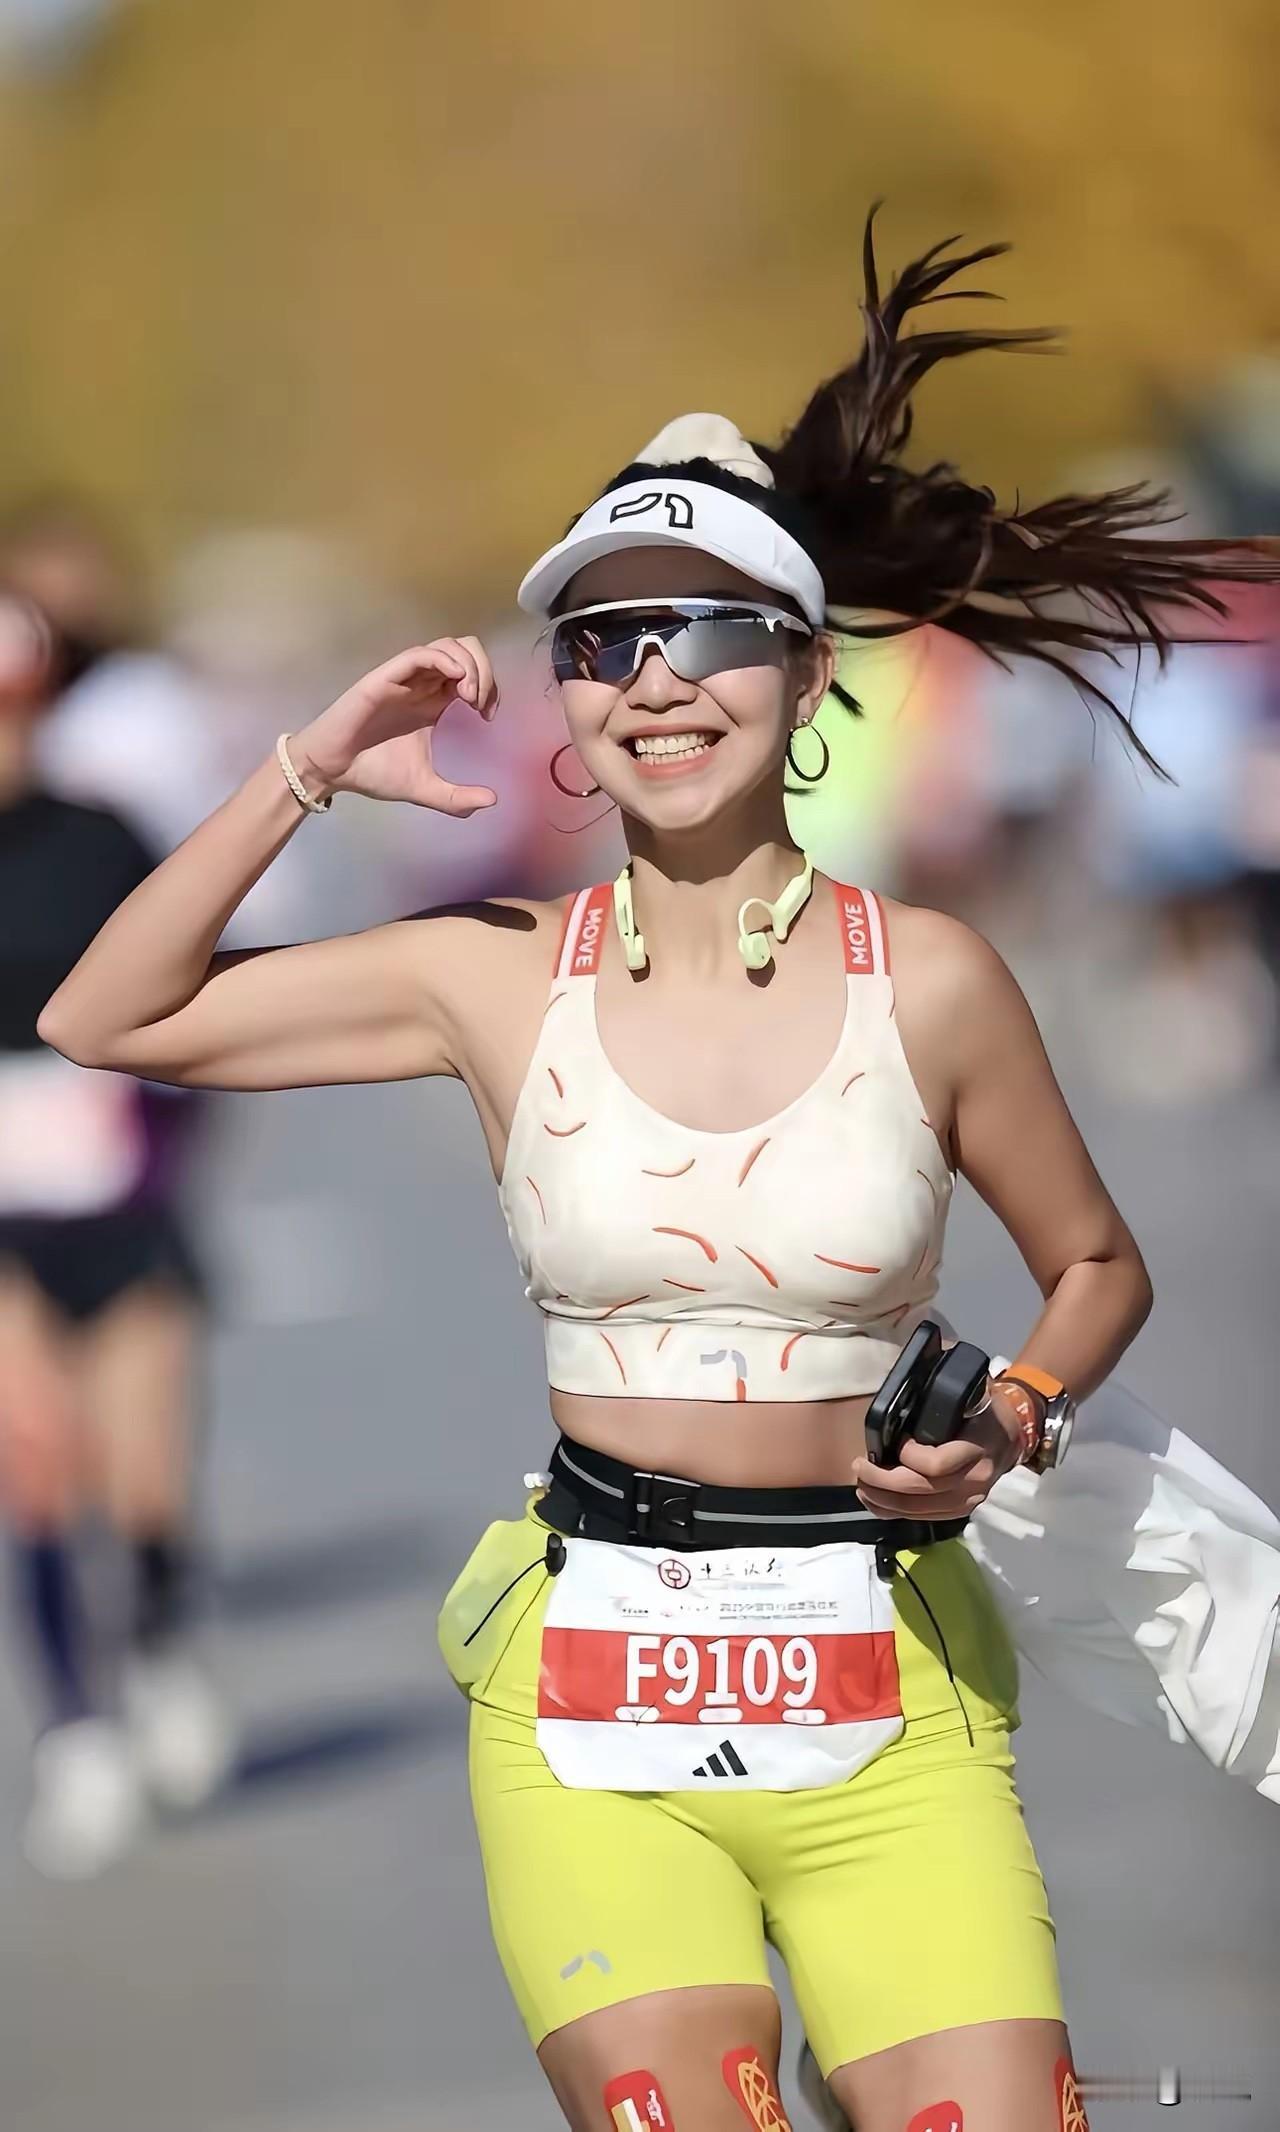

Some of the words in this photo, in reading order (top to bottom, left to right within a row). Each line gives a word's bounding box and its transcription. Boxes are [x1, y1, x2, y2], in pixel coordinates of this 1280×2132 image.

[575, 907, 604, 970] MOVE
[845, 902, 868, 965] MOVE
[626, 1635, 818, 1707] F9109
